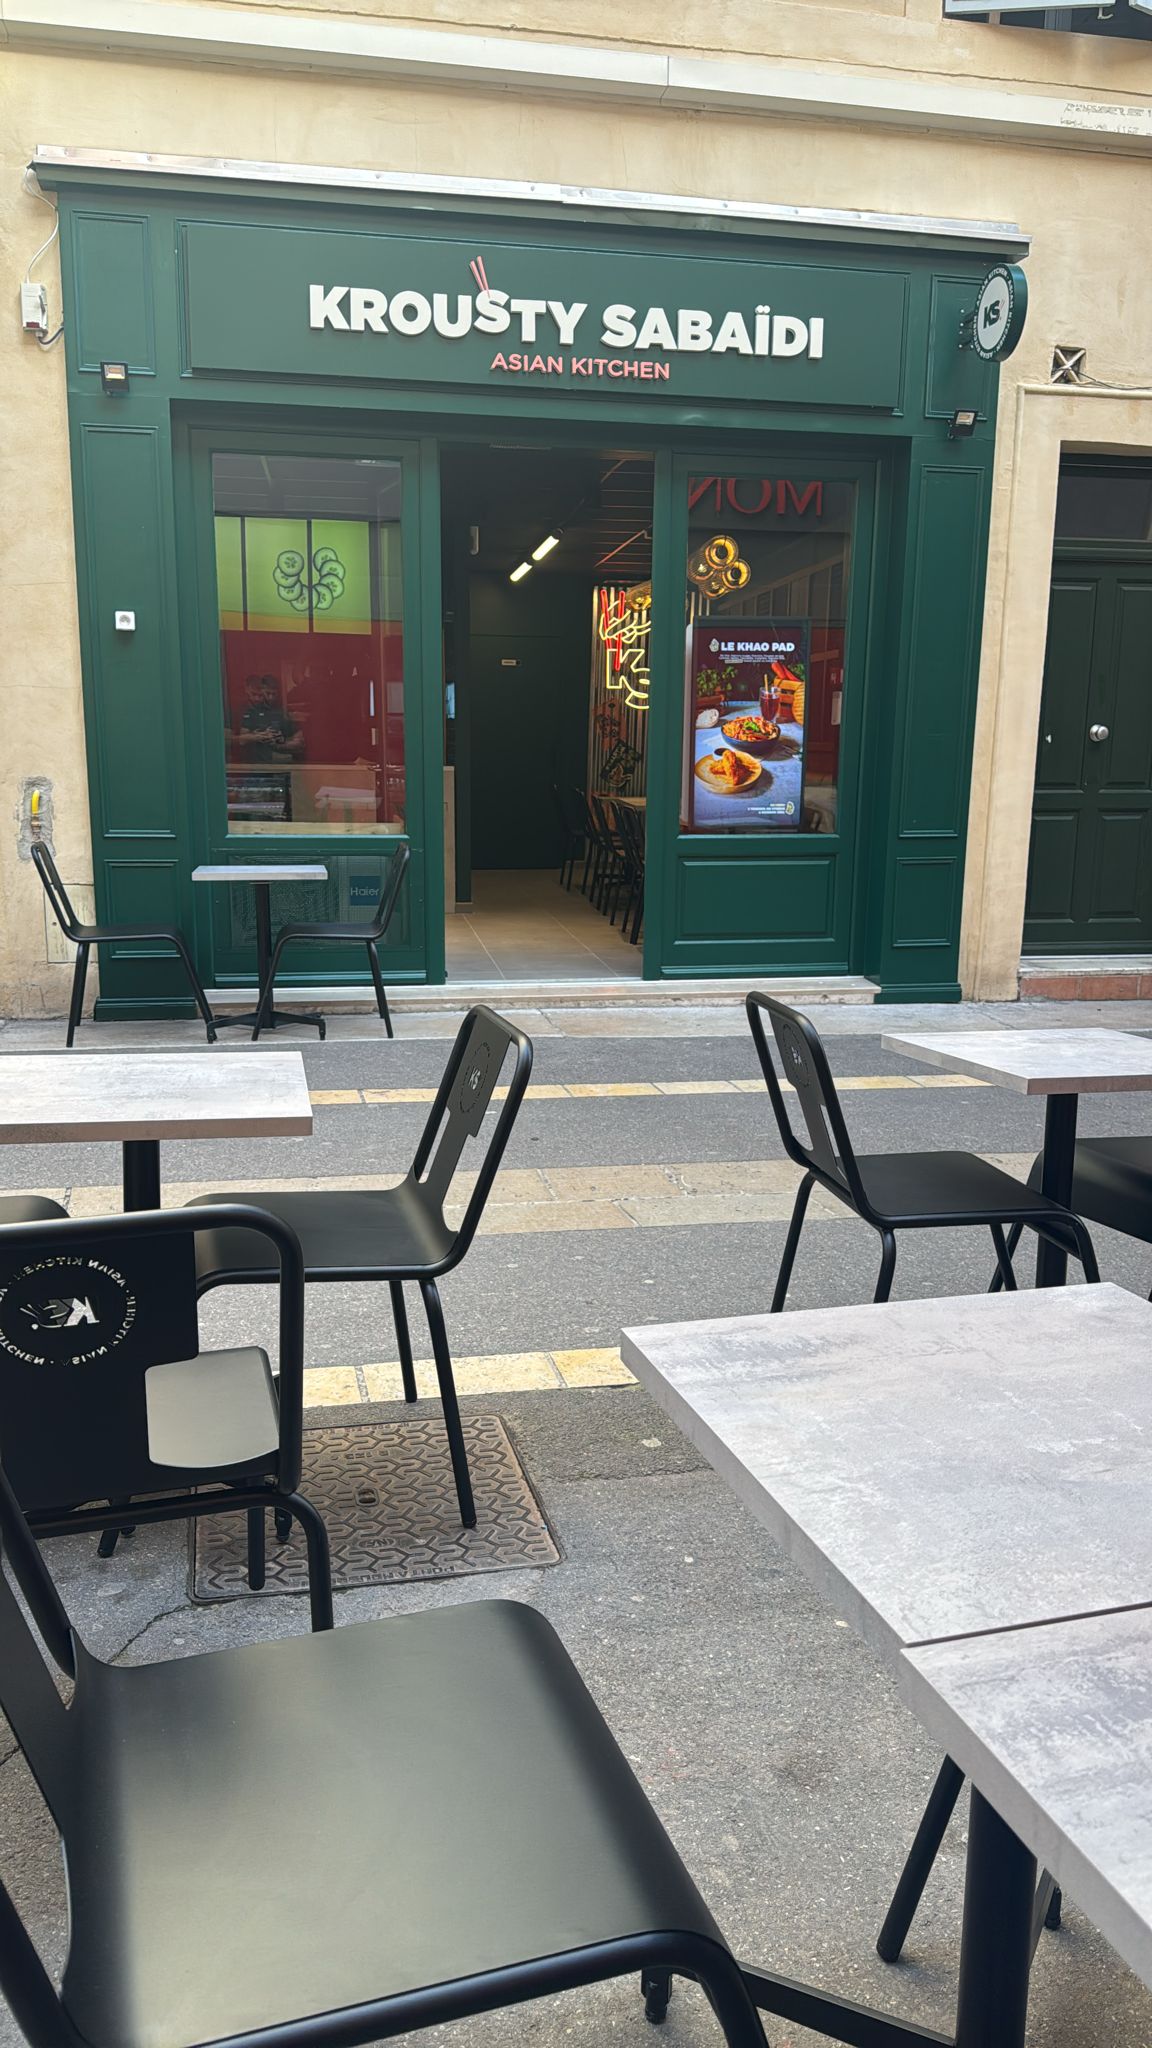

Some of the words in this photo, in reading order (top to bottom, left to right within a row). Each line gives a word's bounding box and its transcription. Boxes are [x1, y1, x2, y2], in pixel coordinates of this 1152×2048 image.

[309, 284, 588, 345] KROUSTY
[600, 304, 825, 360] SABAÏDI
[983, 300, 1001, 329] KS
[490, 353, 564, 374] ASIAN
[570, 357, 670, 380] KITCHEN
[721, 642, 734, 651] LE
[737, 642, 769, 652] KHAO
[772, 642, 795, 652] PAD
[350, 886, 379, 896] Haier
